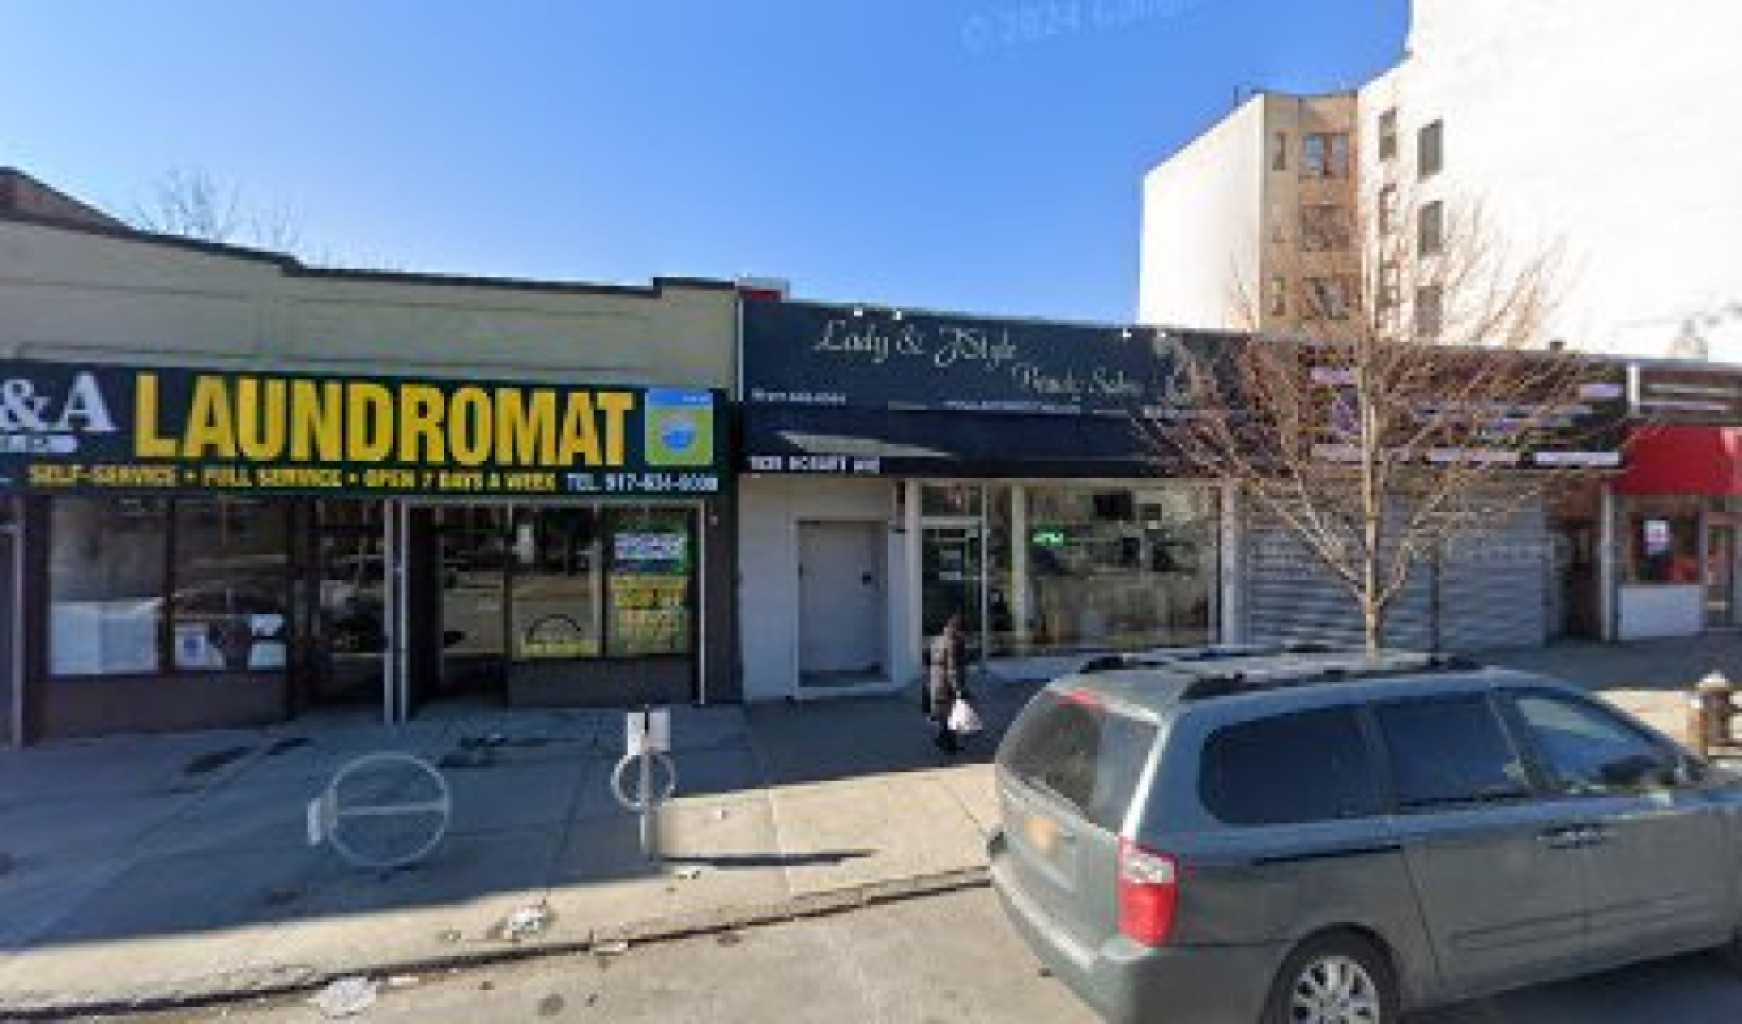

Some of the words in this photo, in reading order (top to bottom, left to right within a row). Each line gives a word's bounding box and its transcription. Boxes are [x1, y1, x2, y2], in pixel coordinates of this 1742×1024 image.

[134, 371, 635, 466] LAUNDROMAT
[28, 464, 177, 487] SELF-SERVICE
[203, 467, 252, 487] FULL
[257, 468, 343, 488] SERVICE
[362, 468, 416, 488] OPEN
[438, 471, 483, 490] DAYS
[486, 471, 501, 490] A
[503, 472, 557, 491] WEEK
